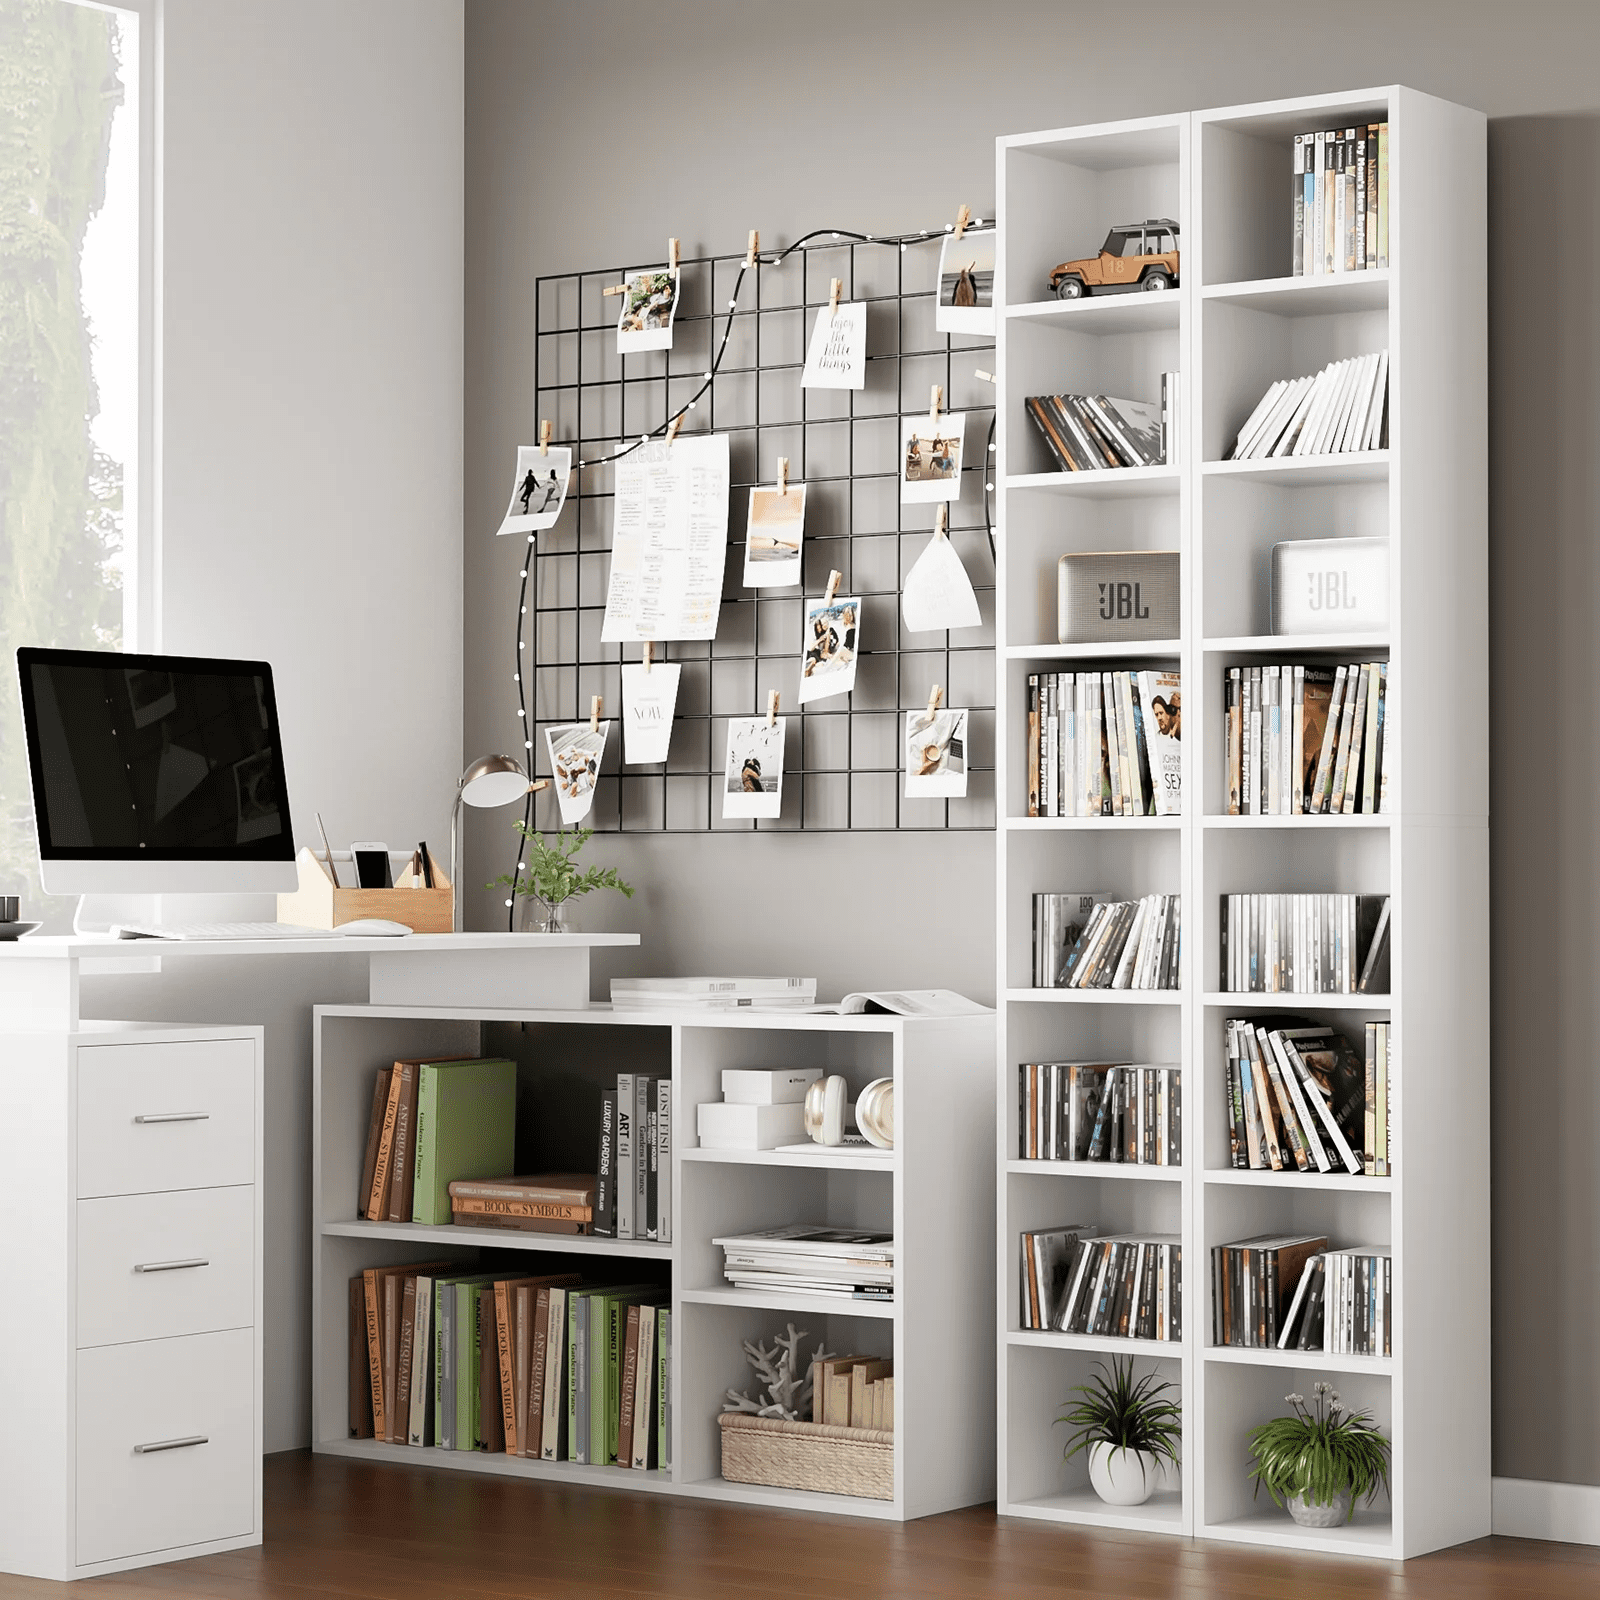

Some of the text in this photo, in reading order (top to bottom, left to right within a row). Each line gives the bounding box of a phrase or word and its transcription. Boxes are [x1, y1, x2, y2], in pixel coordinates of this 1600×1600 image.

[1356, 140, 1365, 264] My Mom's New Boyfriend
[1107, 260, 1125, 274] 18
[819, 357, 851, 373] things
[1098, 582, 1149, 620] JBL
[1306, 571, 1356, 611] JBL
[1040, 688, 1047, 702] My
[1242, 682, 1250, 698] My
[1040, 758, 1048, 805] Boyfriend
[1242, 754, 1250, 802] Boyfriend
[1079, 896, 1094, 908] 100
[384, 1100, 396, 1131] BOOK
[602, 1100, 612, 1134] LUXURY
[619, 1112, 630, 1139] ART
[660, 1085, 668, 1154] LOST FISH
[397, 1103, 408, 1182] ANTIQUAIRES
[600, 1135, 610, 1175] GARDENS
[639, 1125, 647, 1158] Gardens
[373, 1142, 388, 1199] SYMBOLS
[484, 1201, 512, 1214] BOOK
[522, 1203, 572, 1218] SYMBOLS
[367, 1310, 378, 1344] BOOK
[498, 1322, 510, 1357] BOOK
[401, 1319, 413, 1402] ANTIQUAIRES
[437, 1365, 442, 1373] in
[533, 1331, 545, 1415] ANTIQUAIRES
[611, 1352, 616, 1363] IT
[370, 1356, 383, 1417] SYMBOLS
[571, 1378, 577, 1387] in
[623, 1347, 635, 1427] ANTIQUAIRES
[660, 1391, 666, 1399] in
[501, 1369, 514, 1431] SYMBOLS
